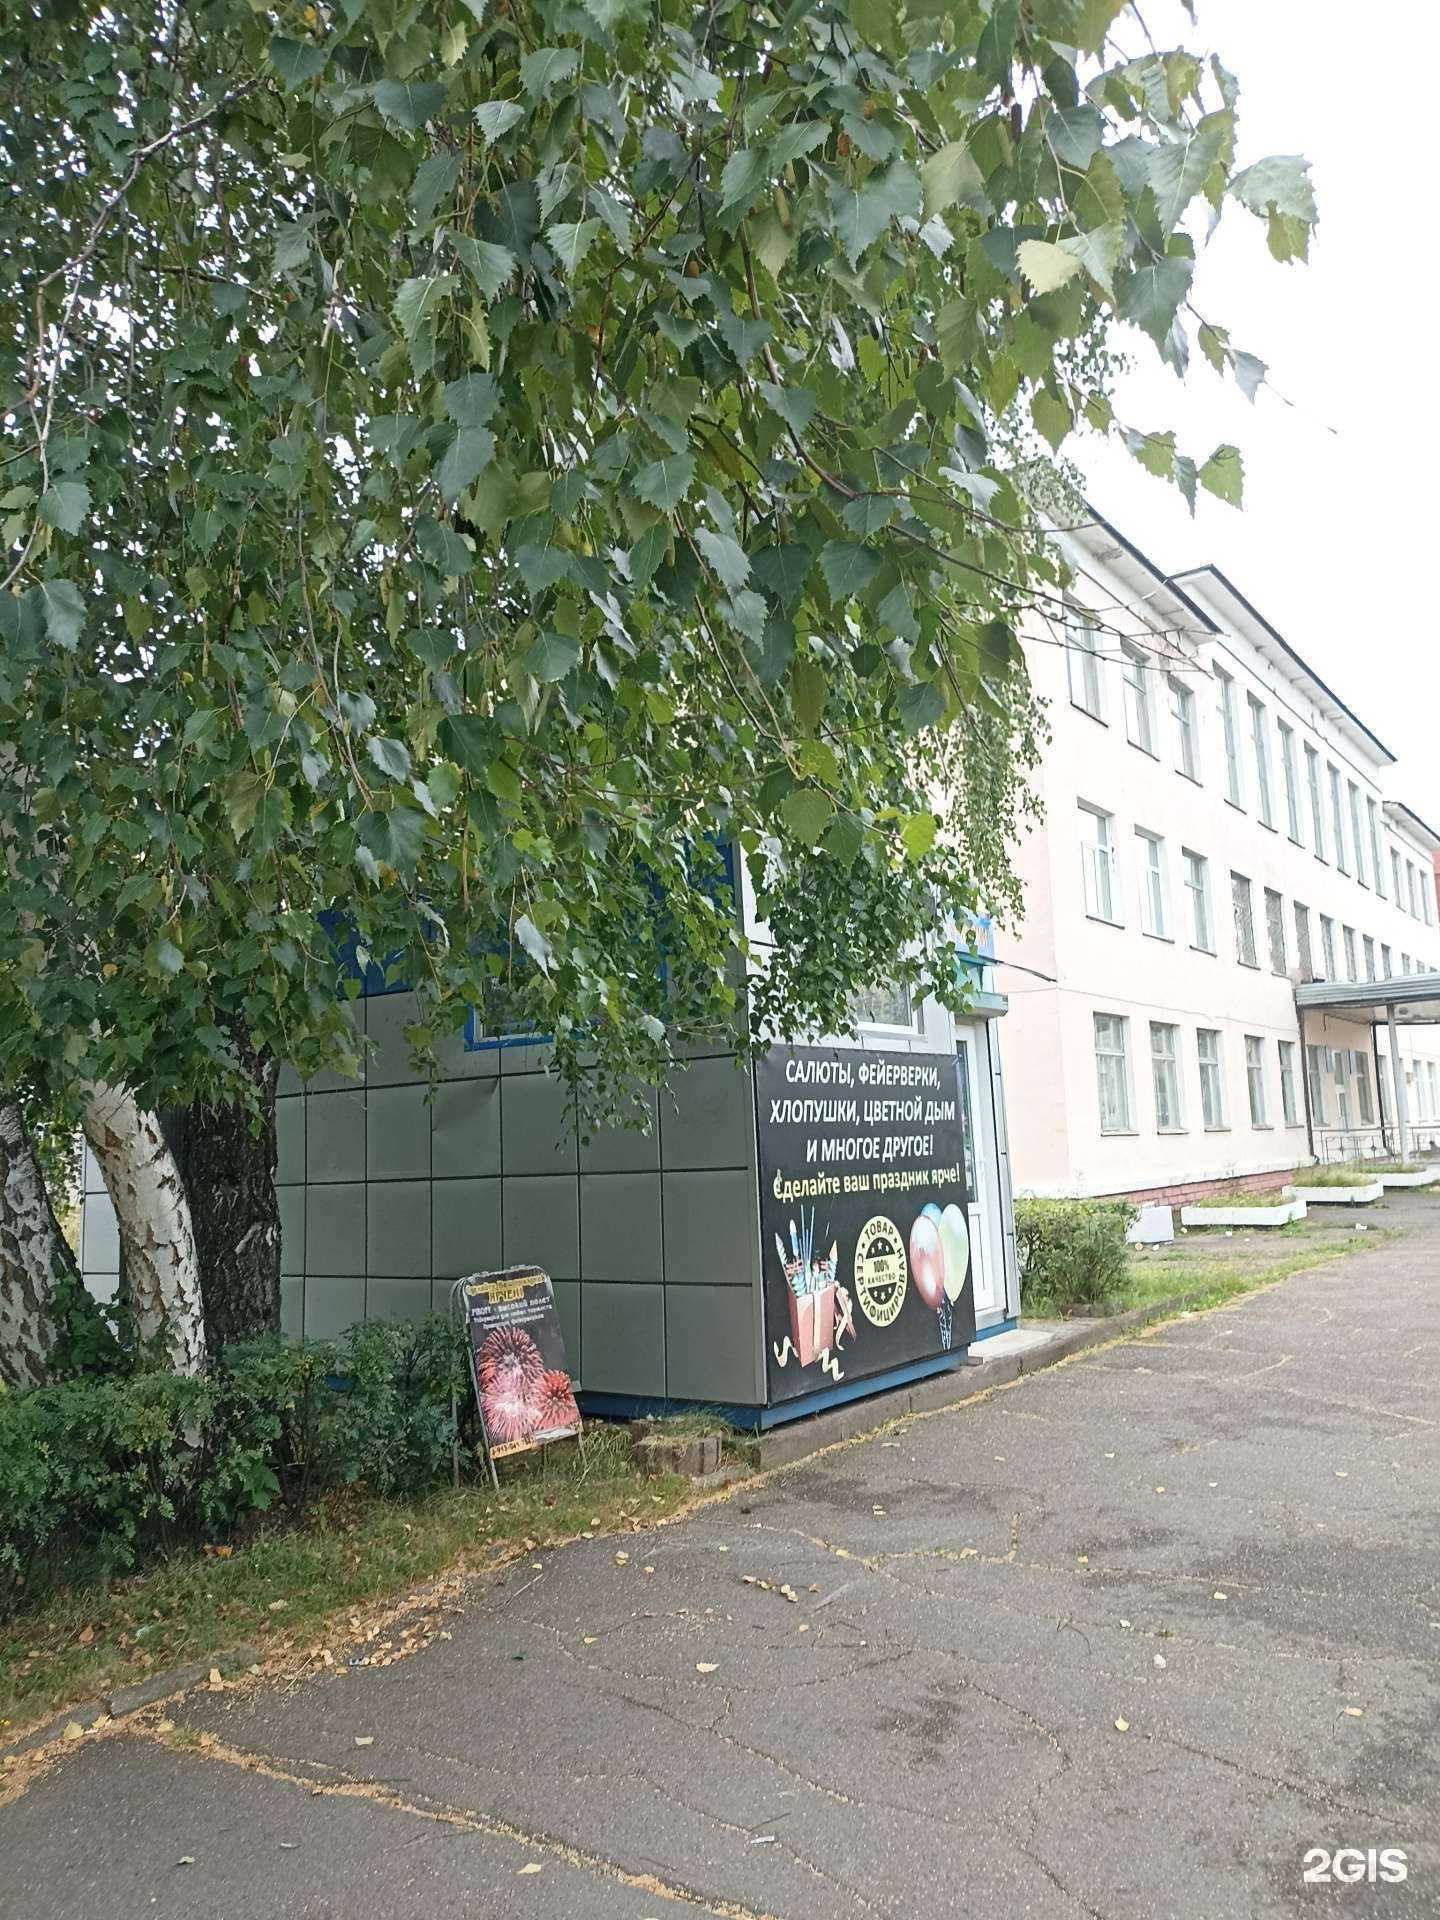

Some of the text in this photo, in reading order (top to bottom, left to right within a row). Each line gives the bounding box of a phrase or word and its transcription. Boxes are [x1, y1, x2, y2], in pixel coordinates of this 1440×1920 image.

[785, 1059, 941, 1090] САЛЮТЫ, ФЕЙЕРВЕРКИ,
[769, 1096, 955, 1126] ХЛОПУШКИ, ЦВЕТНОЙ ДЫМ
[806, 1135, 934, 1163] И МНОГОЕ ДРУГОЕ!
[843, 1175, 869, 1193] ваш
[873, 1170, 930, 1194] праздник
[931, 1163, 960, 1189] ярче!
[864, 1220, 894, 1240] ТОВАР
[873, 1259, 890, 1273] 100%
[856, 1247, 906, 1321] СЕРТИФИЦИРОВАН
